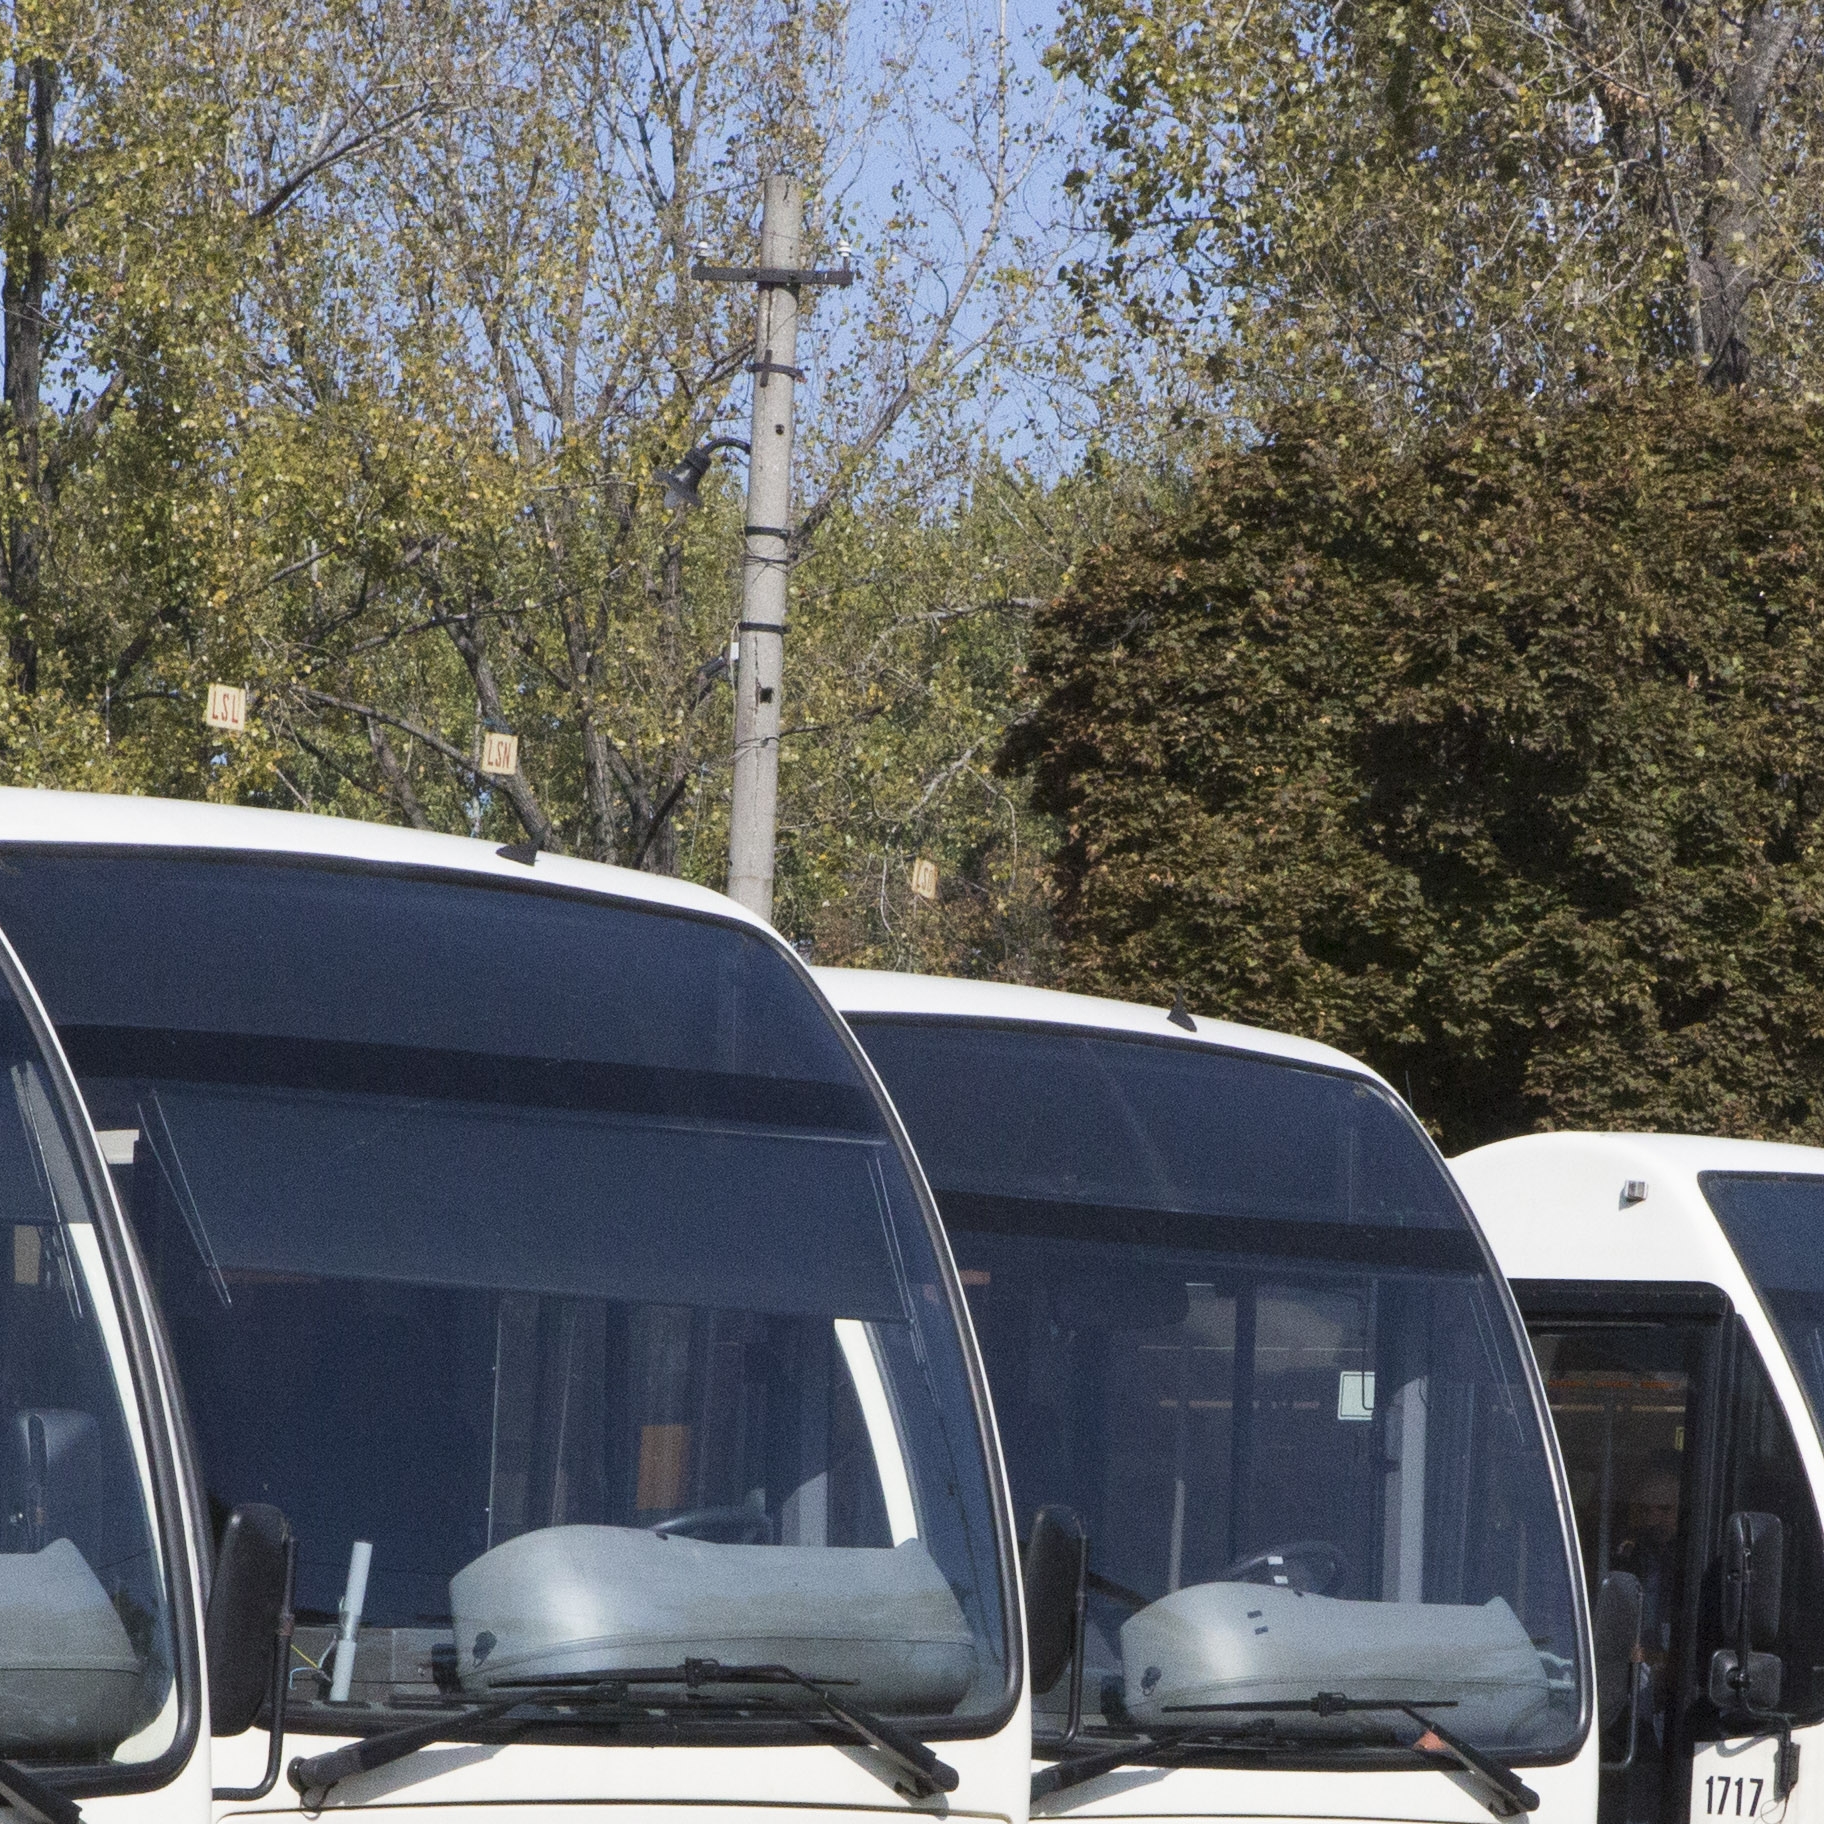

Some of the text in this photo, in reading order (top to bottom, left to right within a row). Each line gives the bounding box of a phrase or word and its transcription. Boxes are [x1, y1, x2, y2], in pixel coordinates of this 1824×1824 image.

[212, 691, 239, 724] LSL
[487, 739, 511, 768] LSN
[1705, 1775, 1764, 1817] 1717
